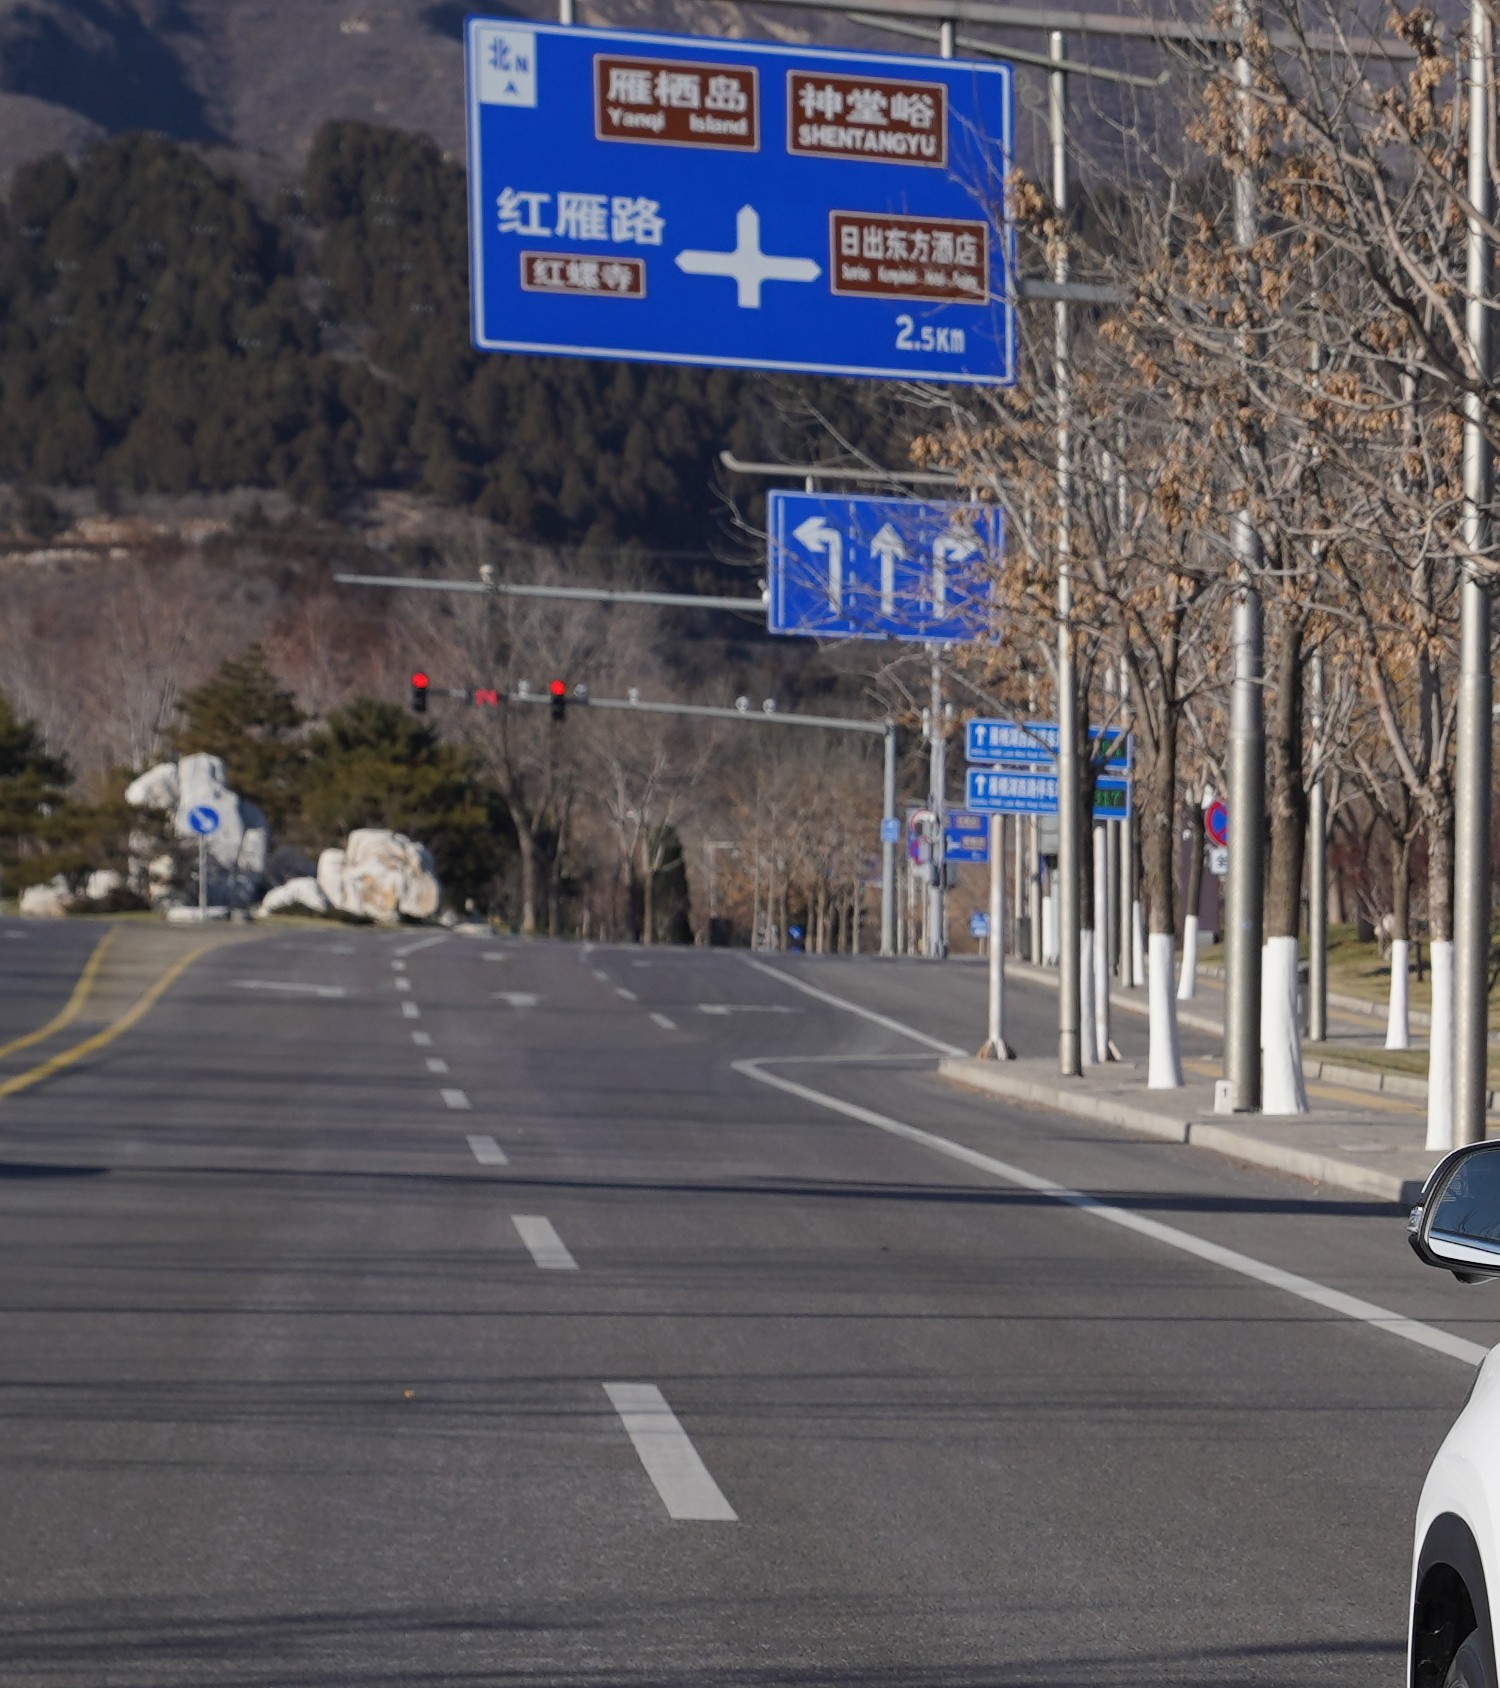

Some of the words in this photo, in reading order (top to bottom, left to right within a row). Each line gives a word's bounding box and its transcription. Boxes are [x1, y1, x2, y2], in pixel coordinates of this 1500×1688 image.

[488, 37, 509, 71] 北
[516, 57, 529, 72] N
[606, 67, 748, 113] 雁栖岛
[798, 82, 936, 129] 神堂峪
[607, 106, 666, 134] Yanqi
[689, 113, 749, 136] Island
[798, 123, 937, 157] SHENTANGYU
[496, 186, 667, 246] 红雁路
[840, 224, 979, 267] 日出东方酒店
